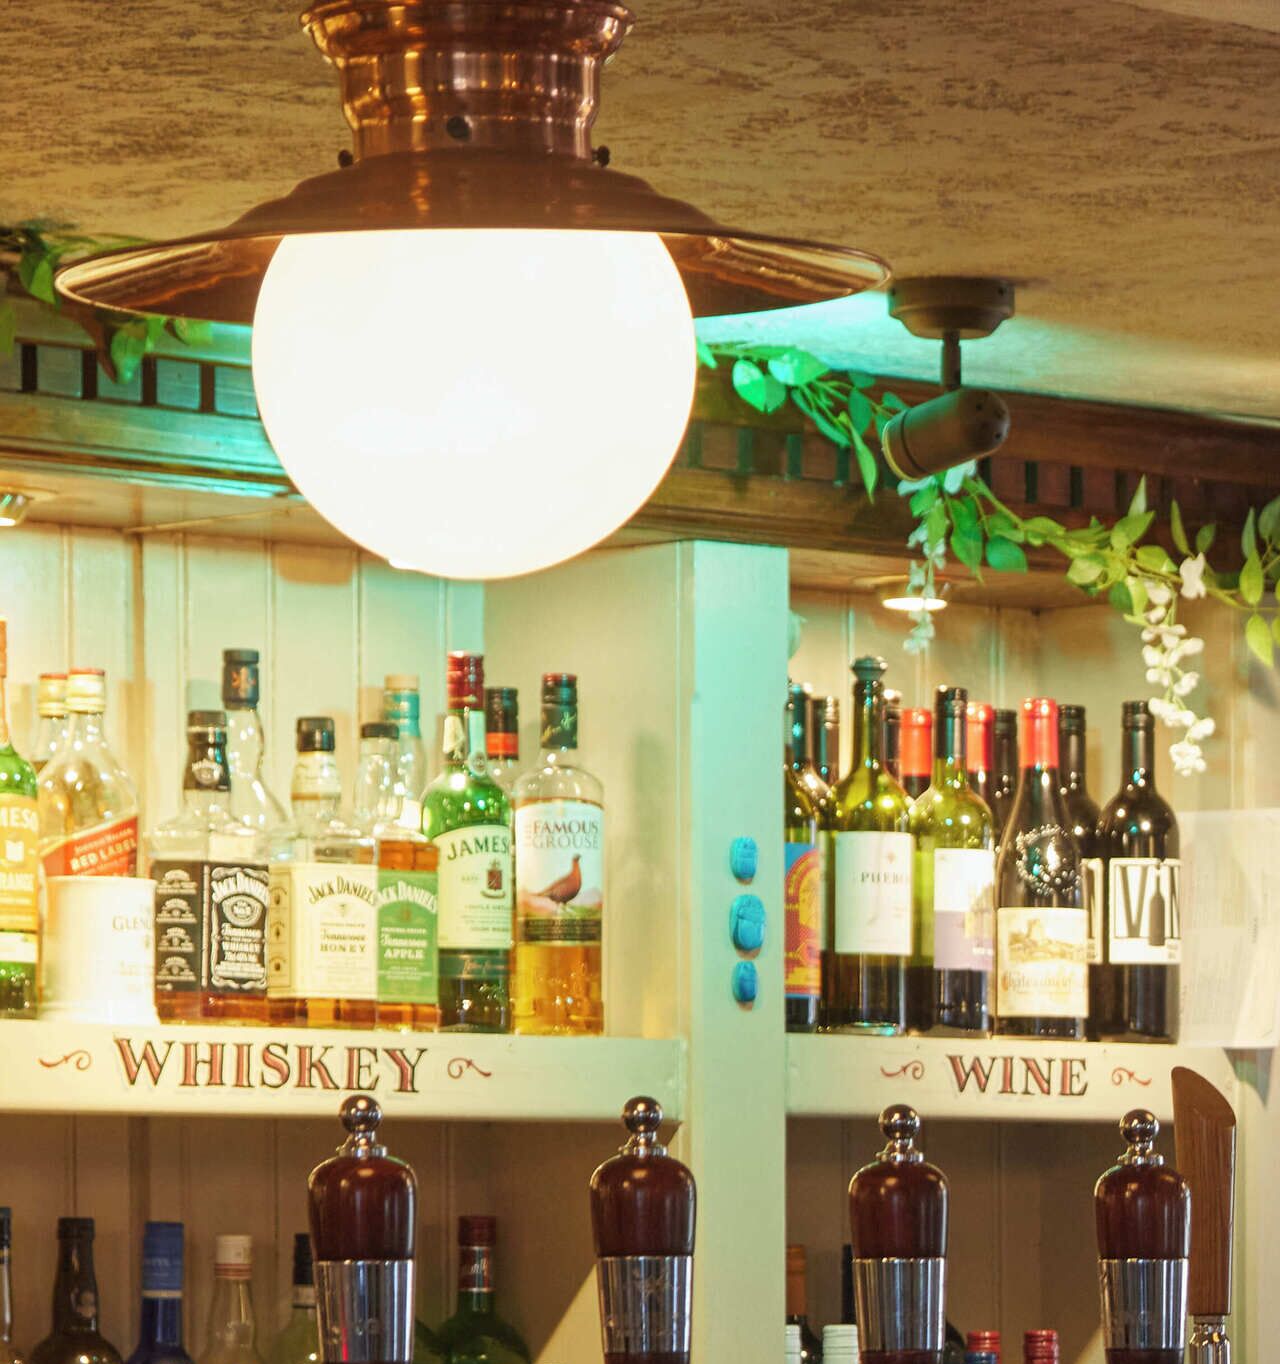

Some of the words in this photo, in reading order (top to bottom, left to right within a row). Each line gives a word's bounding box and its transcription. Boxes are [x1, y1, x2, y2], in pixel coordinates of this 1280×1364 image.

[533, 820, 599, 835] FAMOUS
[532, 835, 600, 850] GROUSE
[70, 854, 99, 872] RED
[211, 877, 237, 905] JACK
[308, 877, 336, 905] JACK
[320, 943, 366, 953] HONEY
[384, 948, 425, 961] APPLE
[113, 1037, 428, 1094] WHISKEY
[944, 1053, 1090, 1097] WINE
